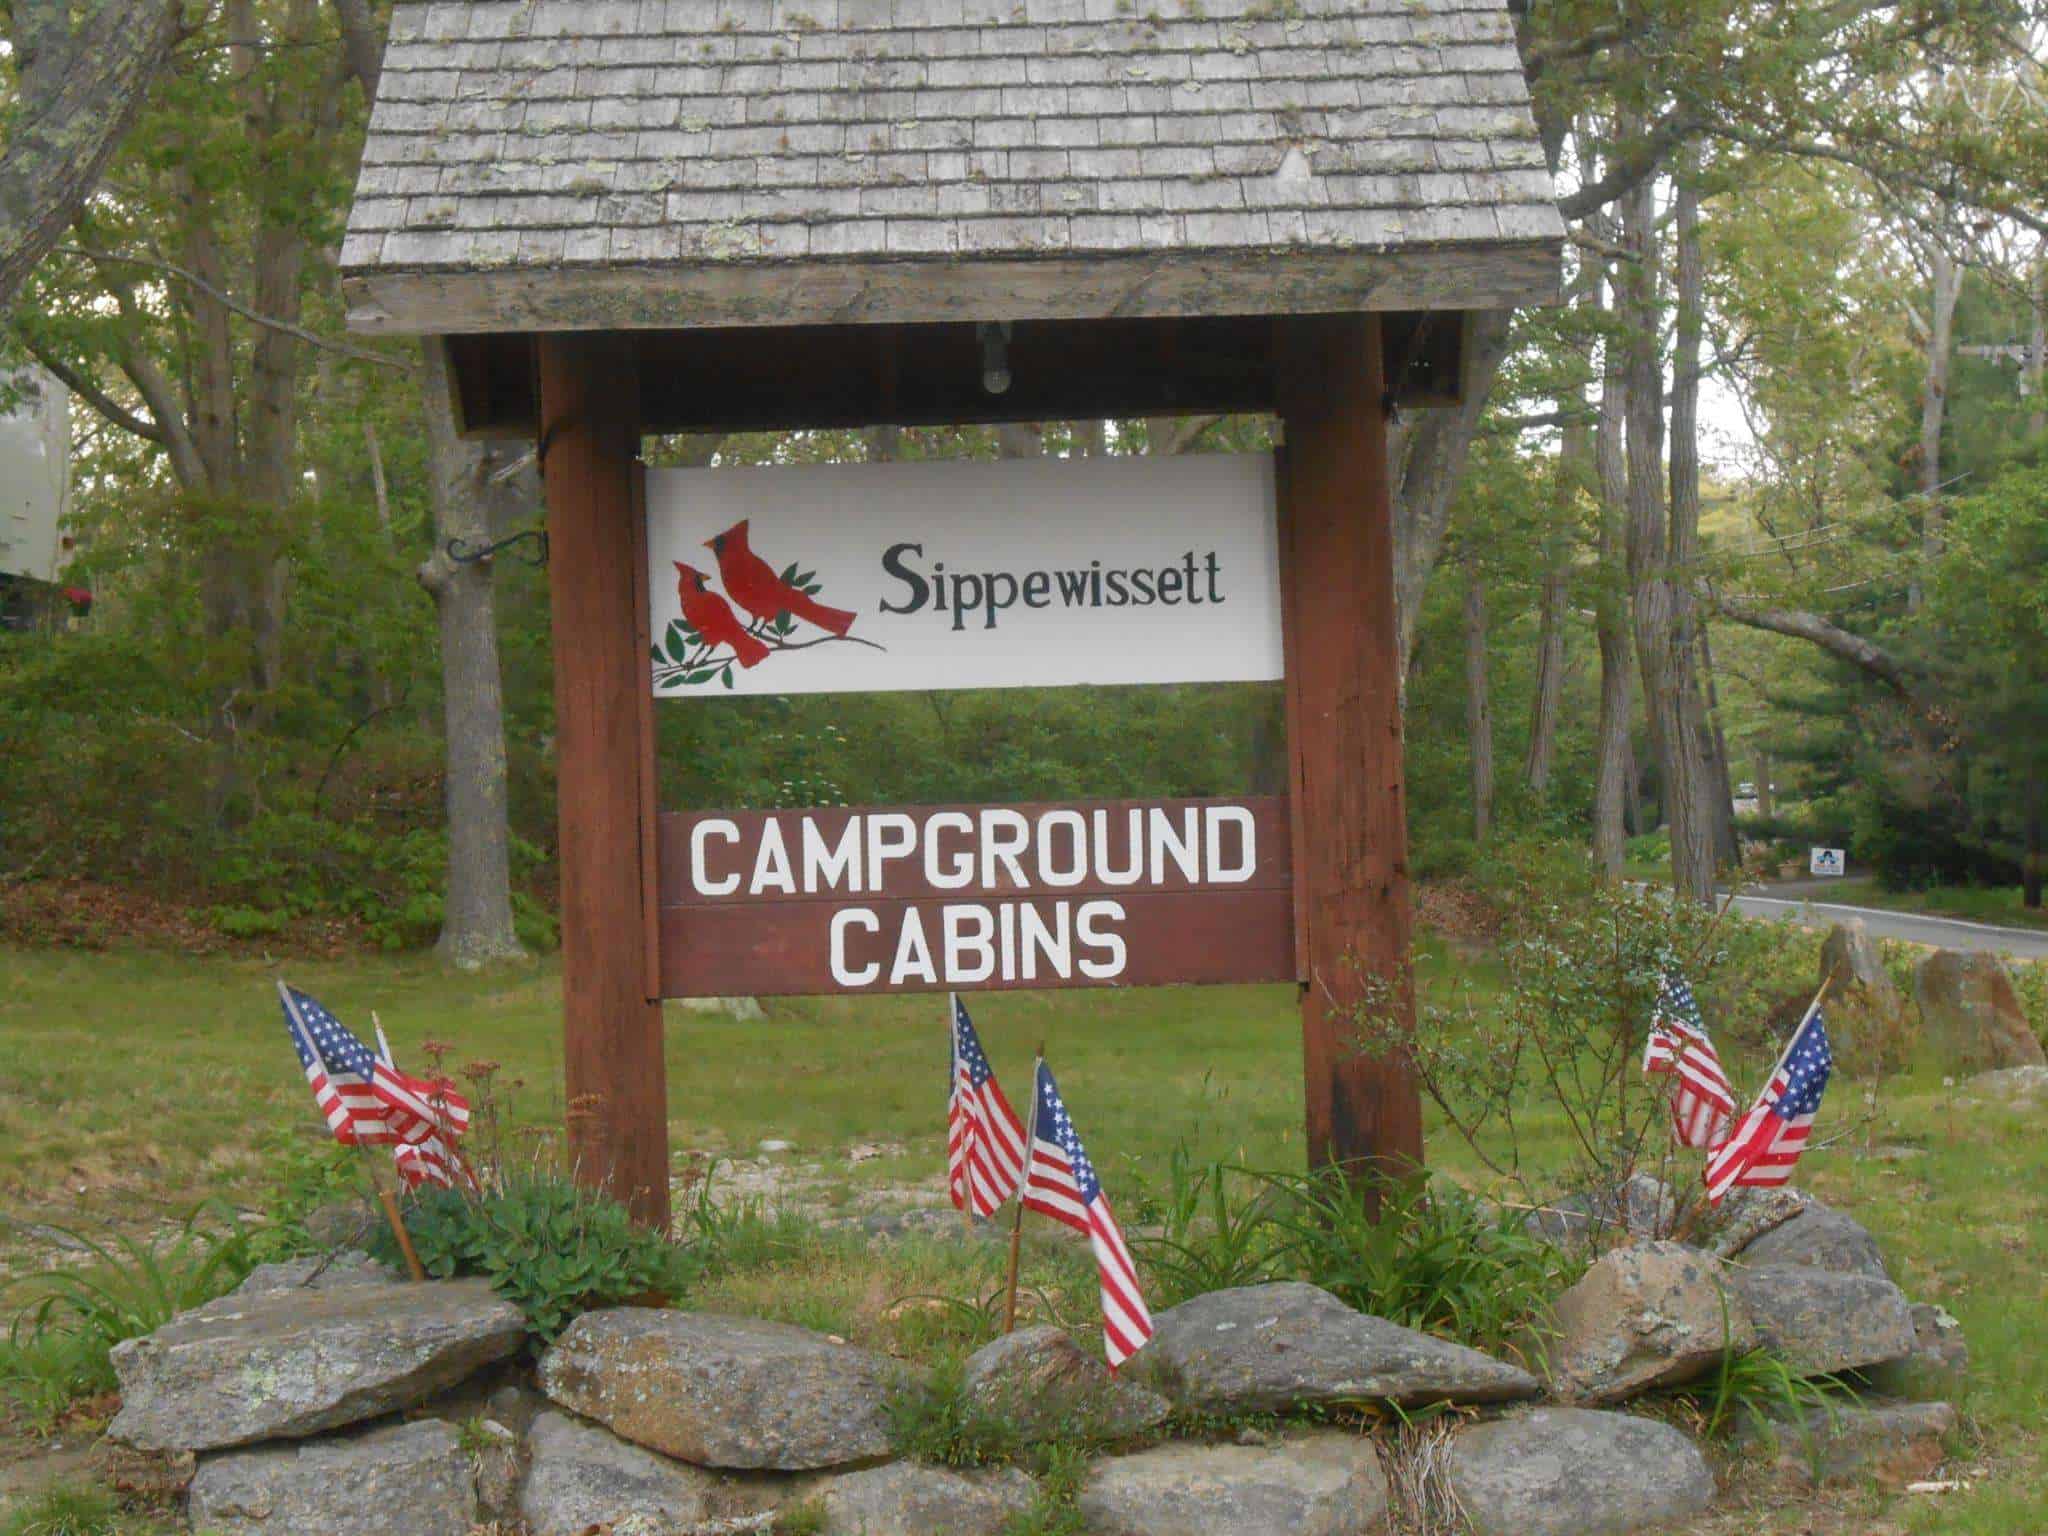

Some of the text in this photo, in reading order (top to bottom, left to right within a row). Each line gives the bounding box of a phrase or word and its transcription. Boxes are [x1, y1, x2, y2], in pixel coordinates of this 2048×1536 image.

[880, 543, 1226, 631] Sippewissett
[690, 805, 1257, 897] CAMPGROUND
[829, 900, 1128, 987] CABINS
